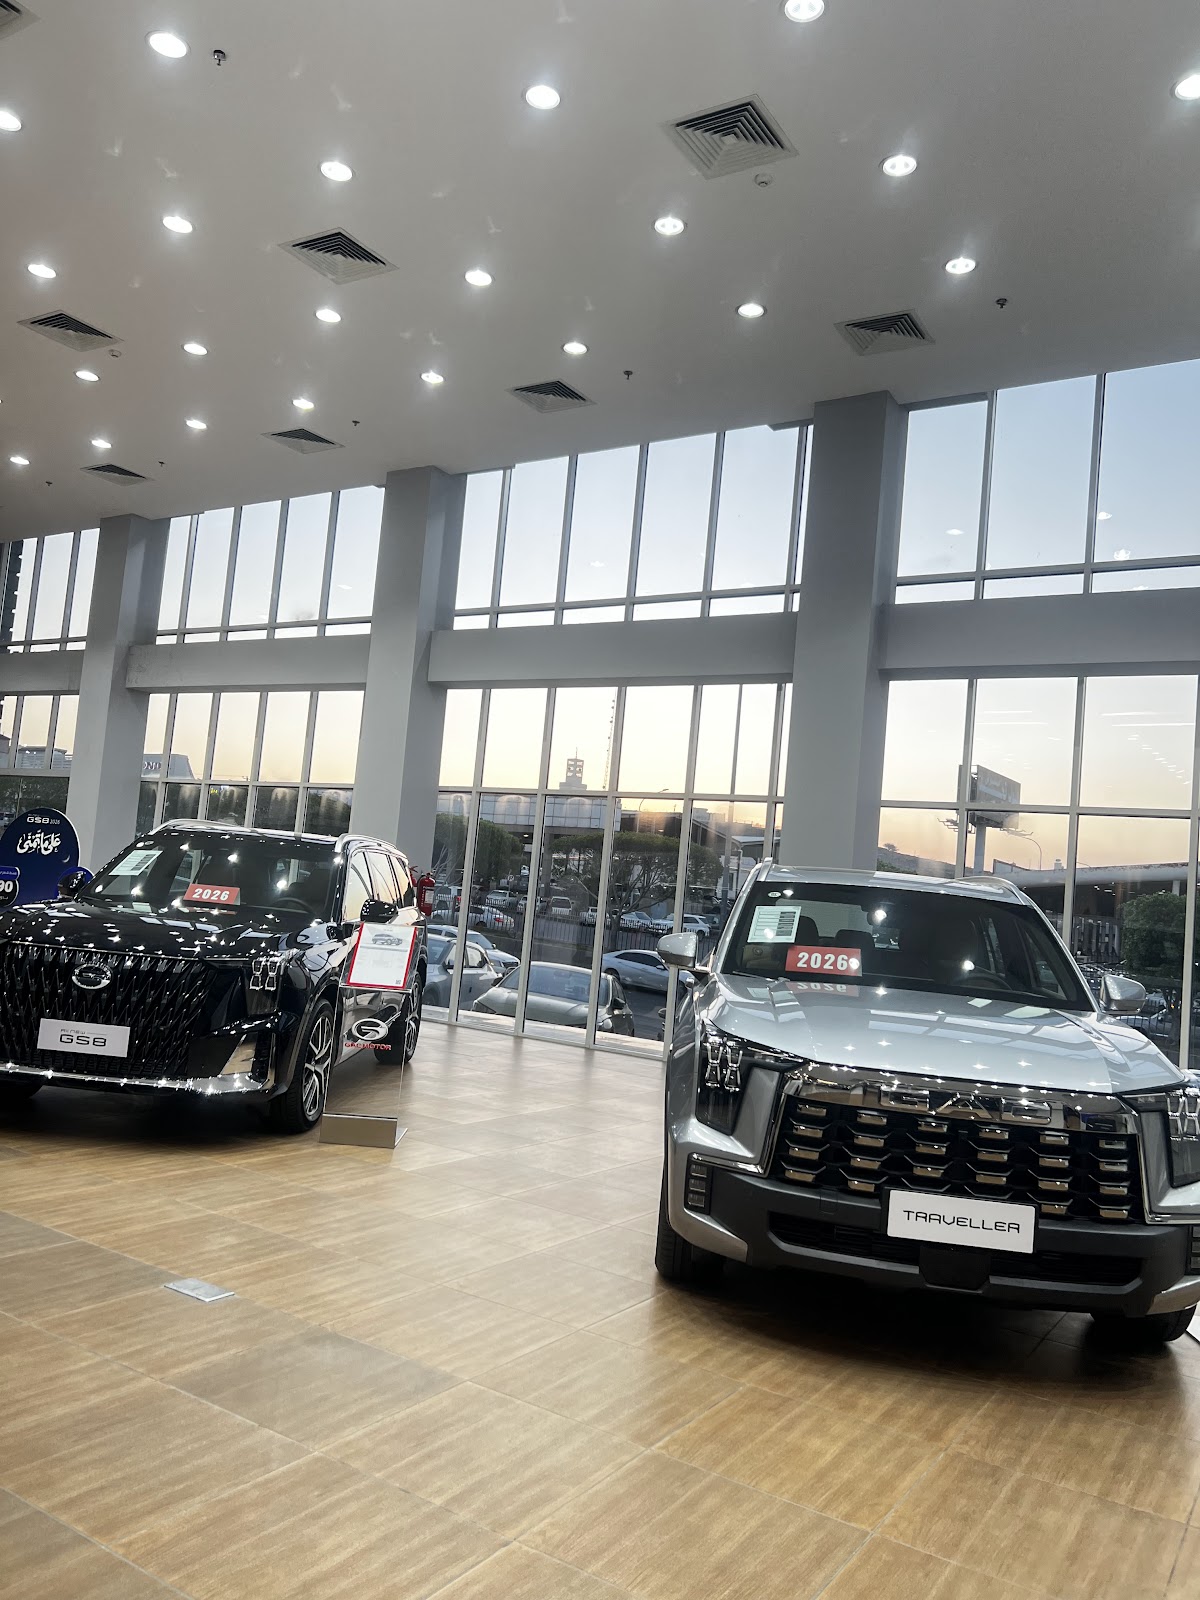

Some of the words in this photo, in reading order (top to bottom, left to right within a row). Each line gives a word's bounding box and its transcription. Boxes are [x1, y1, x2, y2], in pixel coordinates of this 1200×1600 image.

[26, 816, 50, 824] GS8
[192, 888, 230, 901] 2026
[796, 952, 848, 971] 2026
[59, 1034, 107, 1047] GS8
[902, 1209, 1021, 1234] TRAVELLER
